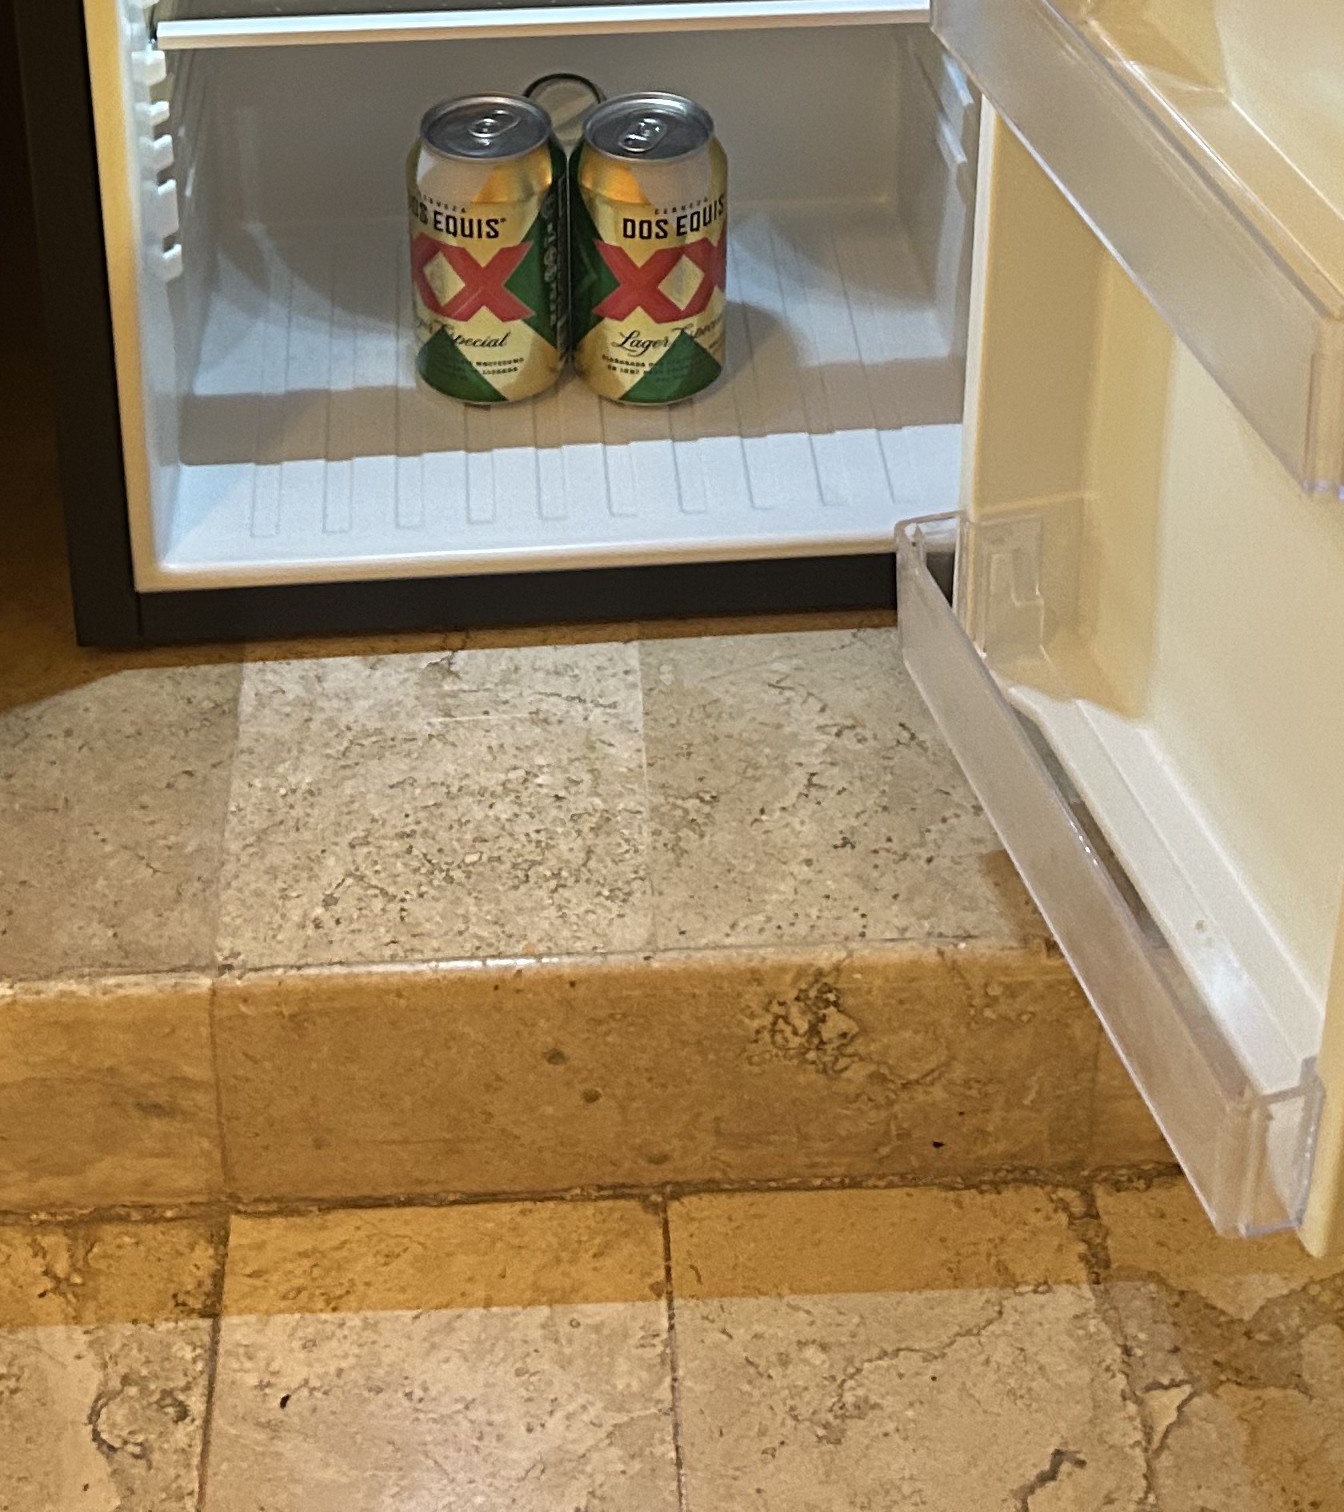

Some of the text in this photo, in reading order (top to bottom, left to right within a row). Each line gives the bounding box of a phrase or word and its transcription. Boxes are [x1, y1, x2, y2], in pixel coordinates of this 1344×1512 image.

[411, 196, 428, 225] OS
[622, 194, 726, 240] DOS EQUIS
[610, 329, 669, 357] Lager
